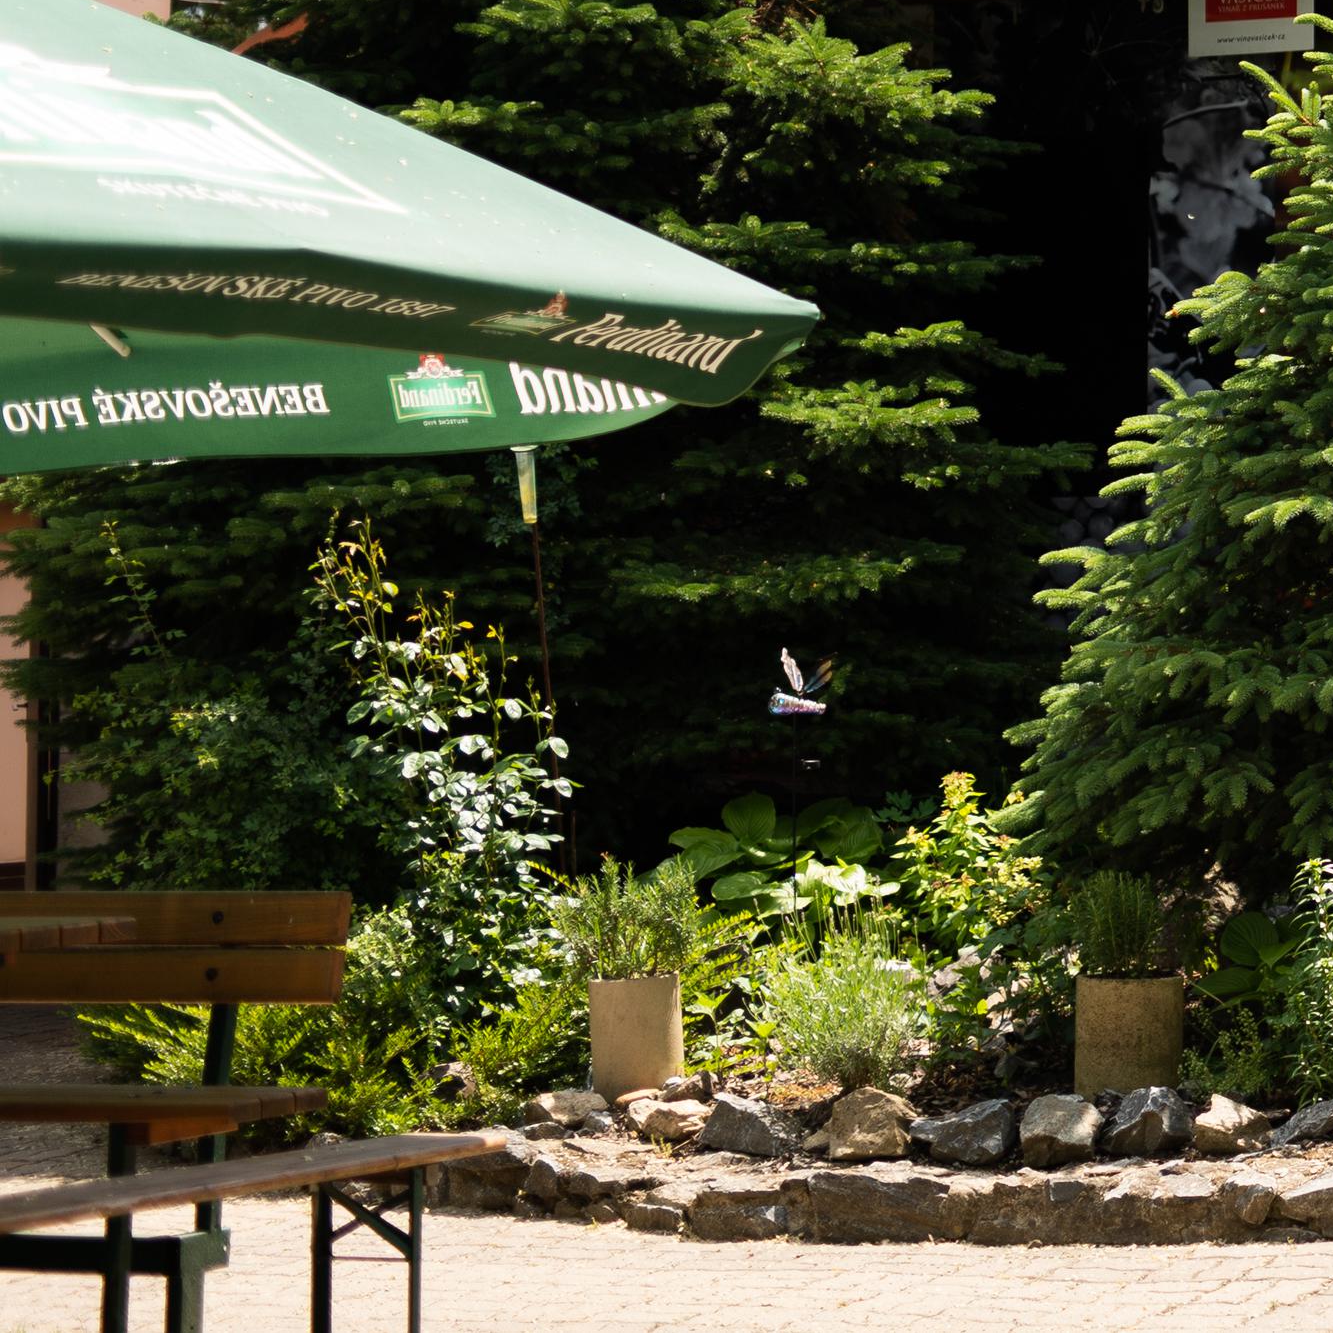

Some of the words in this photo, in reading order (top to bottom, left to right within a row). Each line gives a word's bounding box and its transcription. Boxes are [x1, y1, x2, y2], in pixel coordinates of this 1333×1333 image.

[54, 272, 303, 300] BENEŠOVSKÉ
[289, 283, 376, 309] PIVO
[367, 296, 457, 318] 1897
[549, 312, 764, 374] Ferdinand
